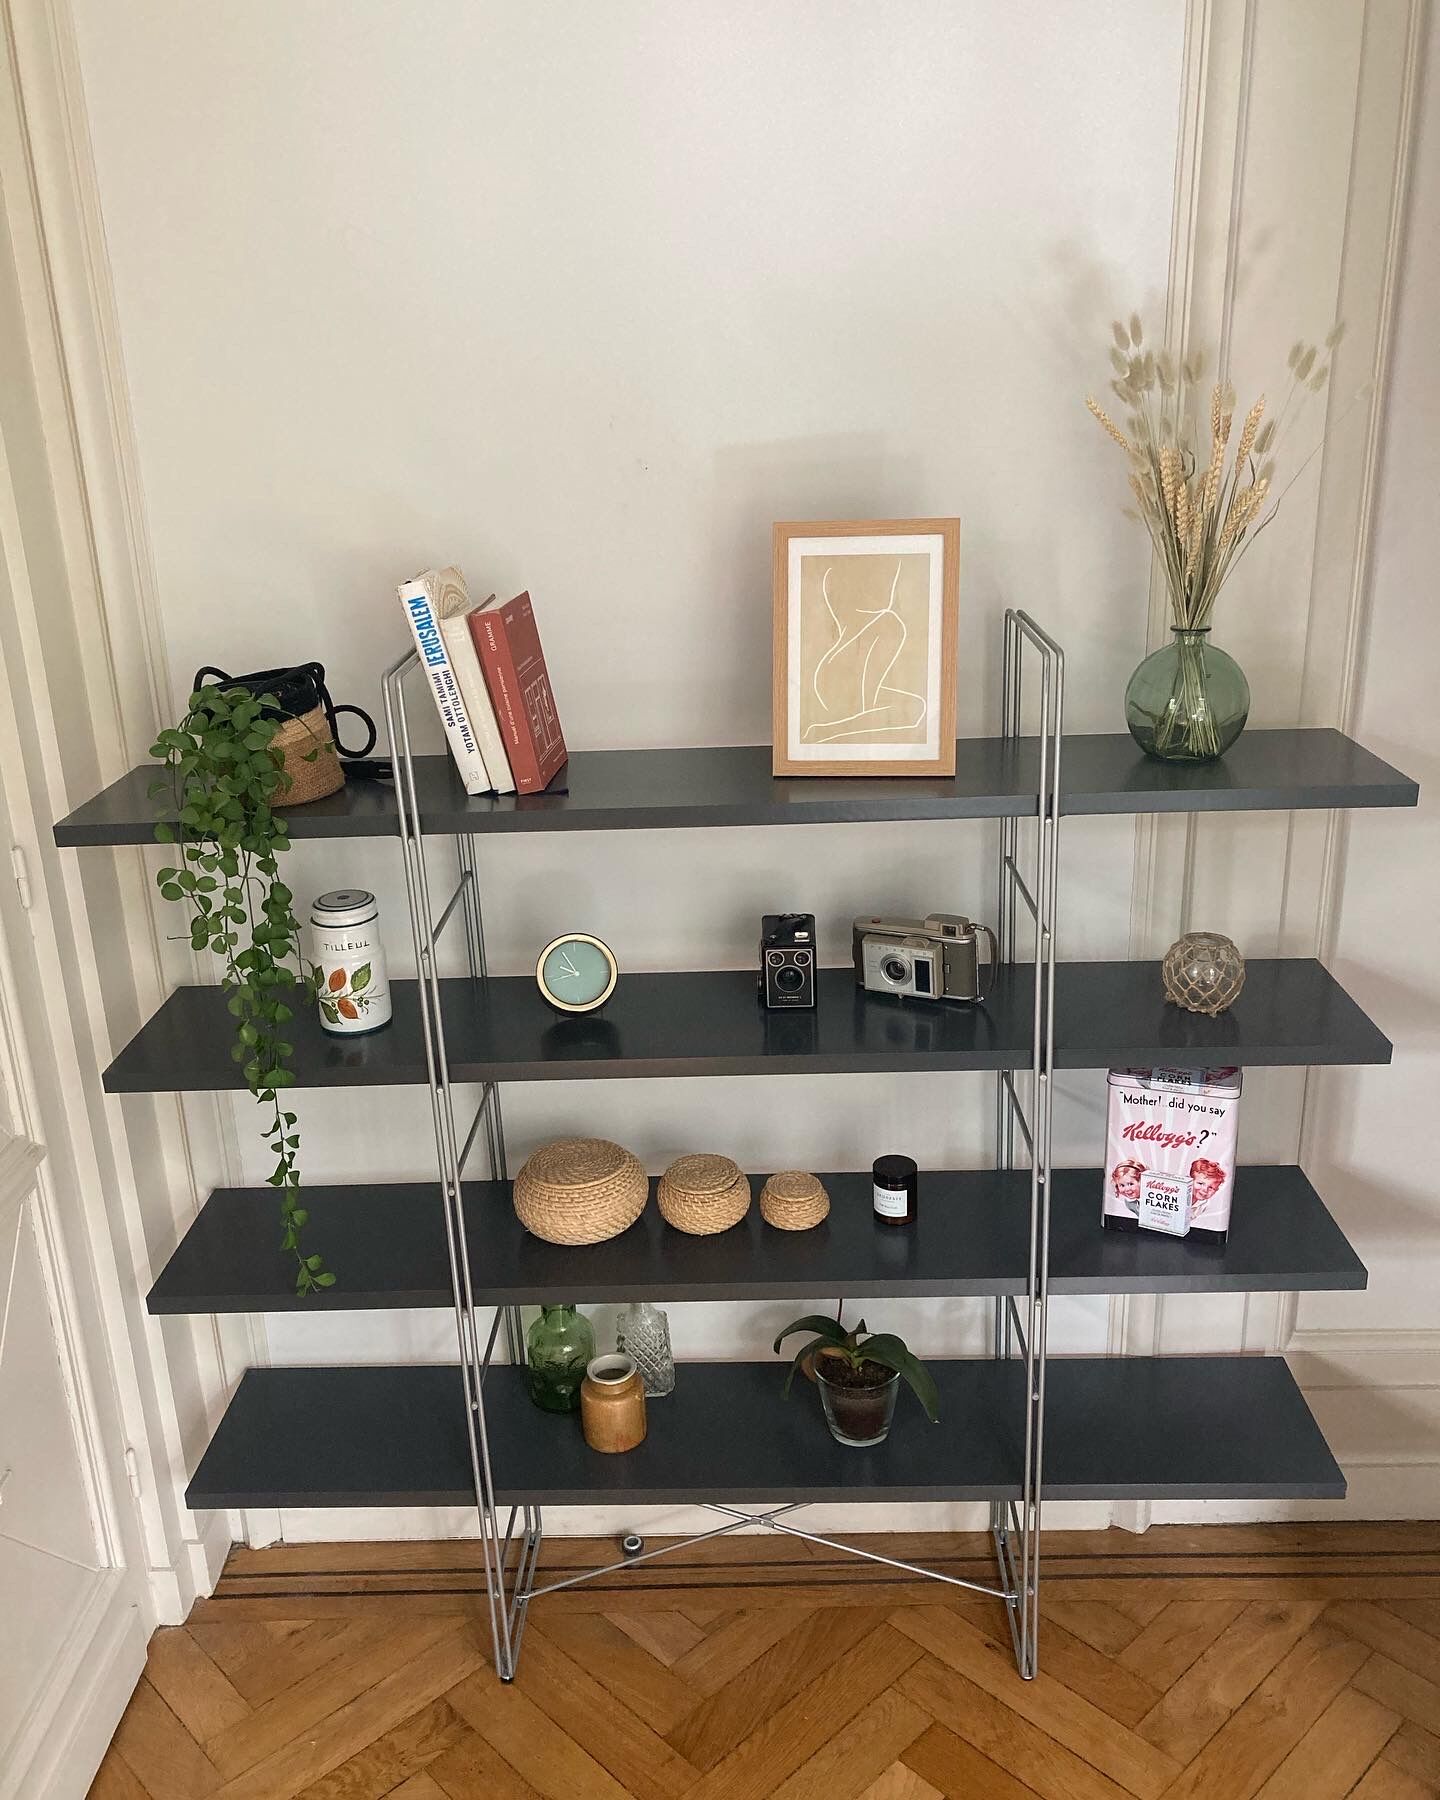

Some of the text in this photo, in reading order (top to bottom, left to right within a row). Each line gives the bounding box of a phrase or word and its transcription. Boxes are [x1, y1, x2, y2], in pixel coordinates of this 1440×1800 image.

[408, 596, 447, 667] JERUSALEM
[485, 621, 497, 651] GRAMME
[432, 672, 456, 728] SAMI TAMIMI
[442, 669, 475, 754] YOTAM OTTOLENGHI
[511, 726, 519, 745] Manuel
[323, 940, 370, 951] TILLEUL
[1168, 1097, 1184, 1109] did
[1188, 1103, 1206, 1113] you
[1209, 1107, 1225, 1117] say
[1146, 1180, 1180, 1194] Kellogg's
[1145, 1198, 1179, 1212] FLAKES
[1148, 1191, 1178, 1204] CORN
